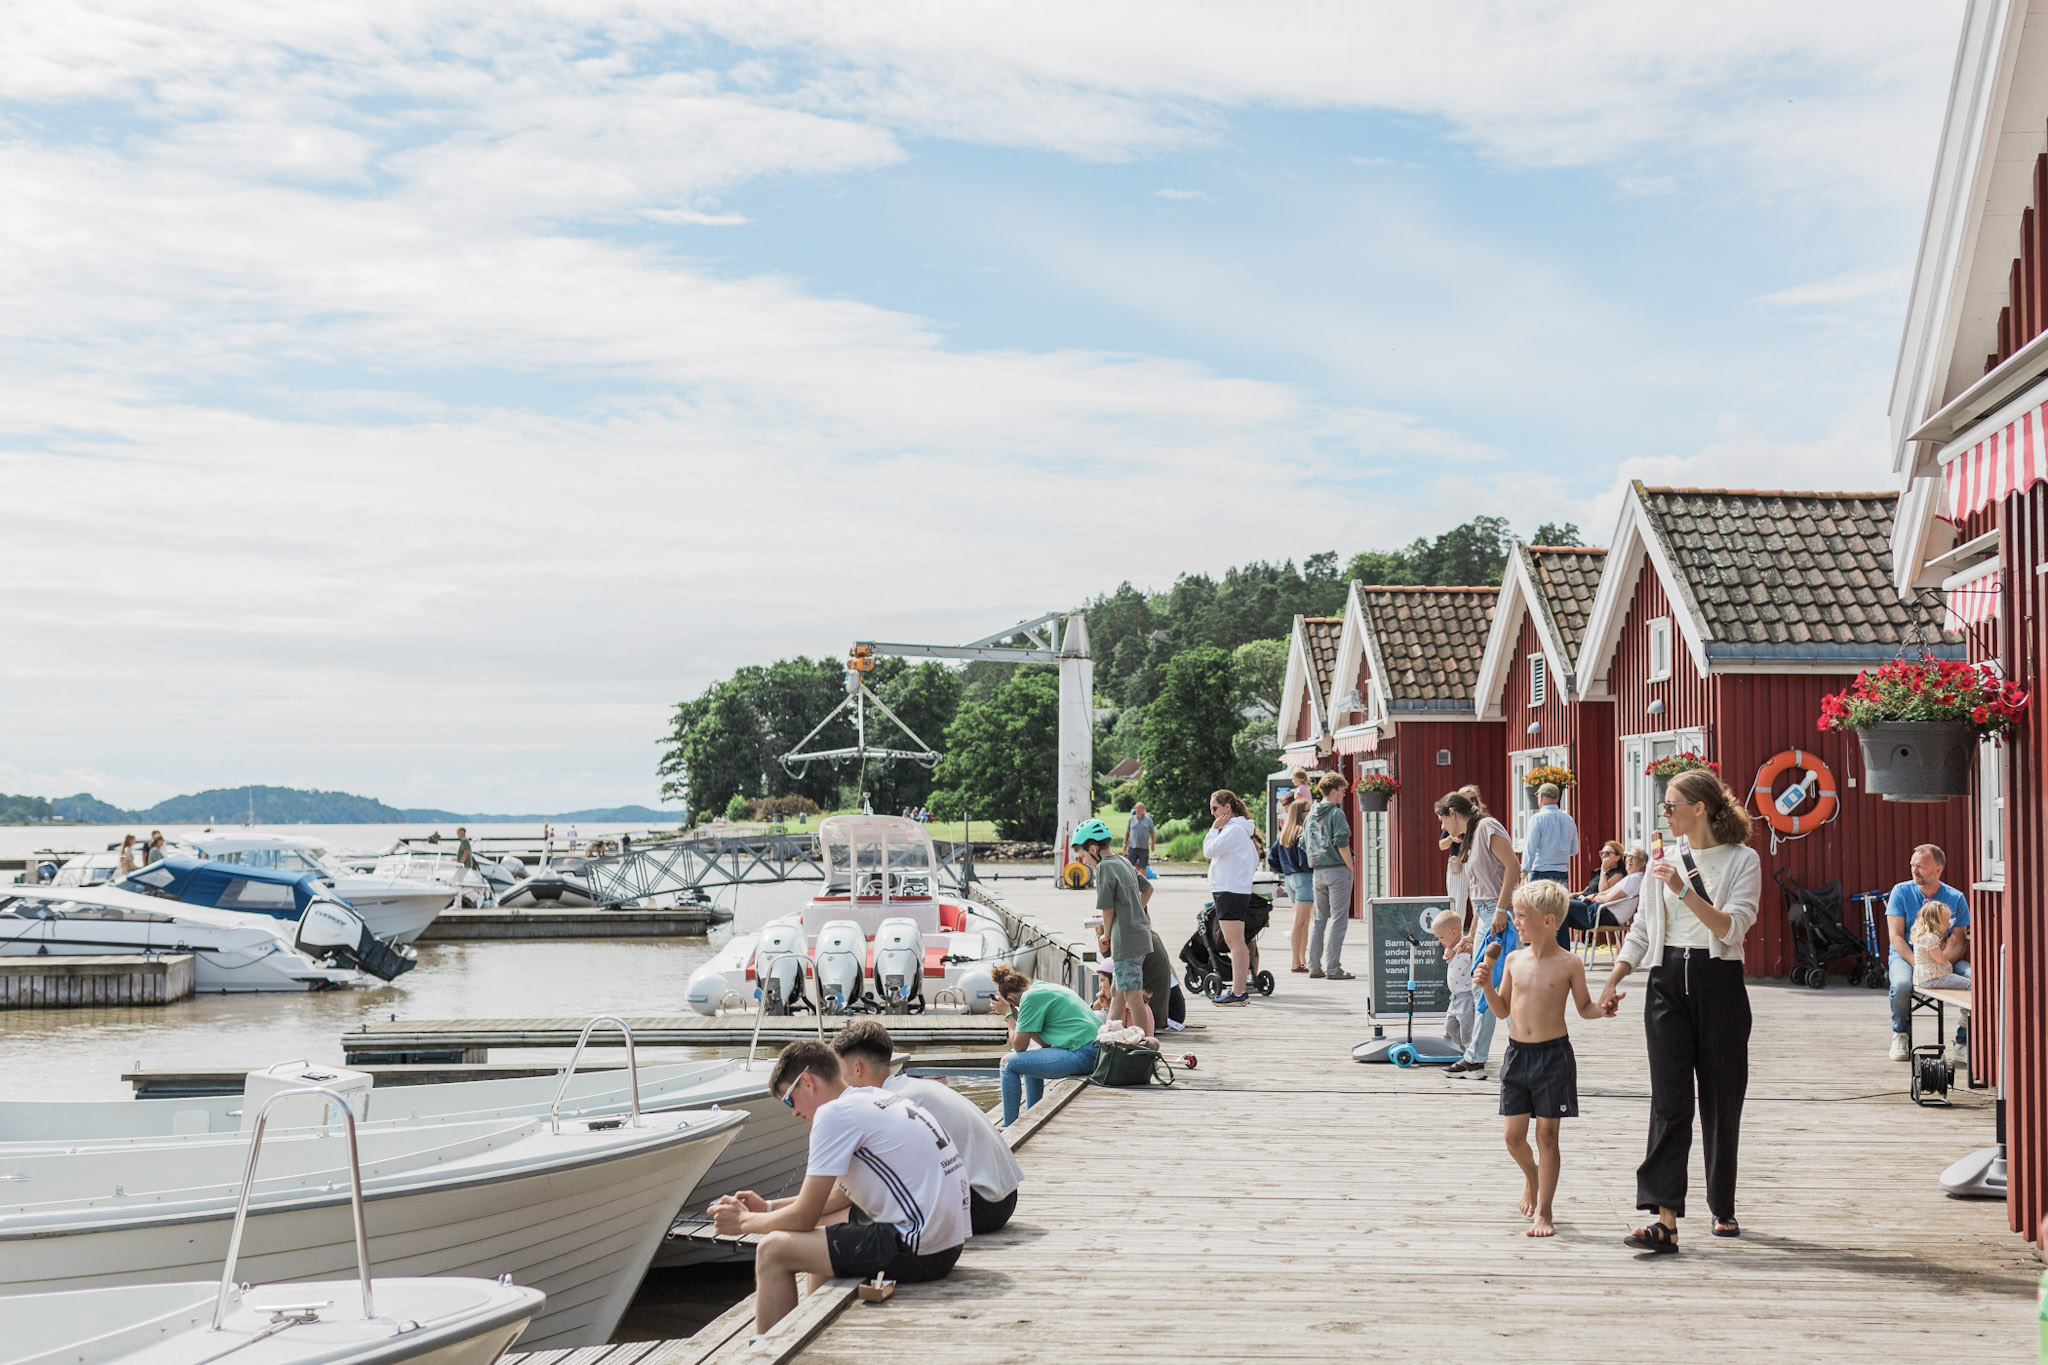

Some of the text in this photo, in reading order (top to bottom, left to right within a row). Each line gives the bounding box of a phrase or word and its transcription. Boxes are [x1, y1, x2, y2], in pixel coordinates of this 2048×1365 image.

[1385, 939, 1404, 947] Barn
[1385, 948, 1408, 956] under
[1385, 957, 1424, 965] nærheen
[1385, 966, 1408, 974] vann!
